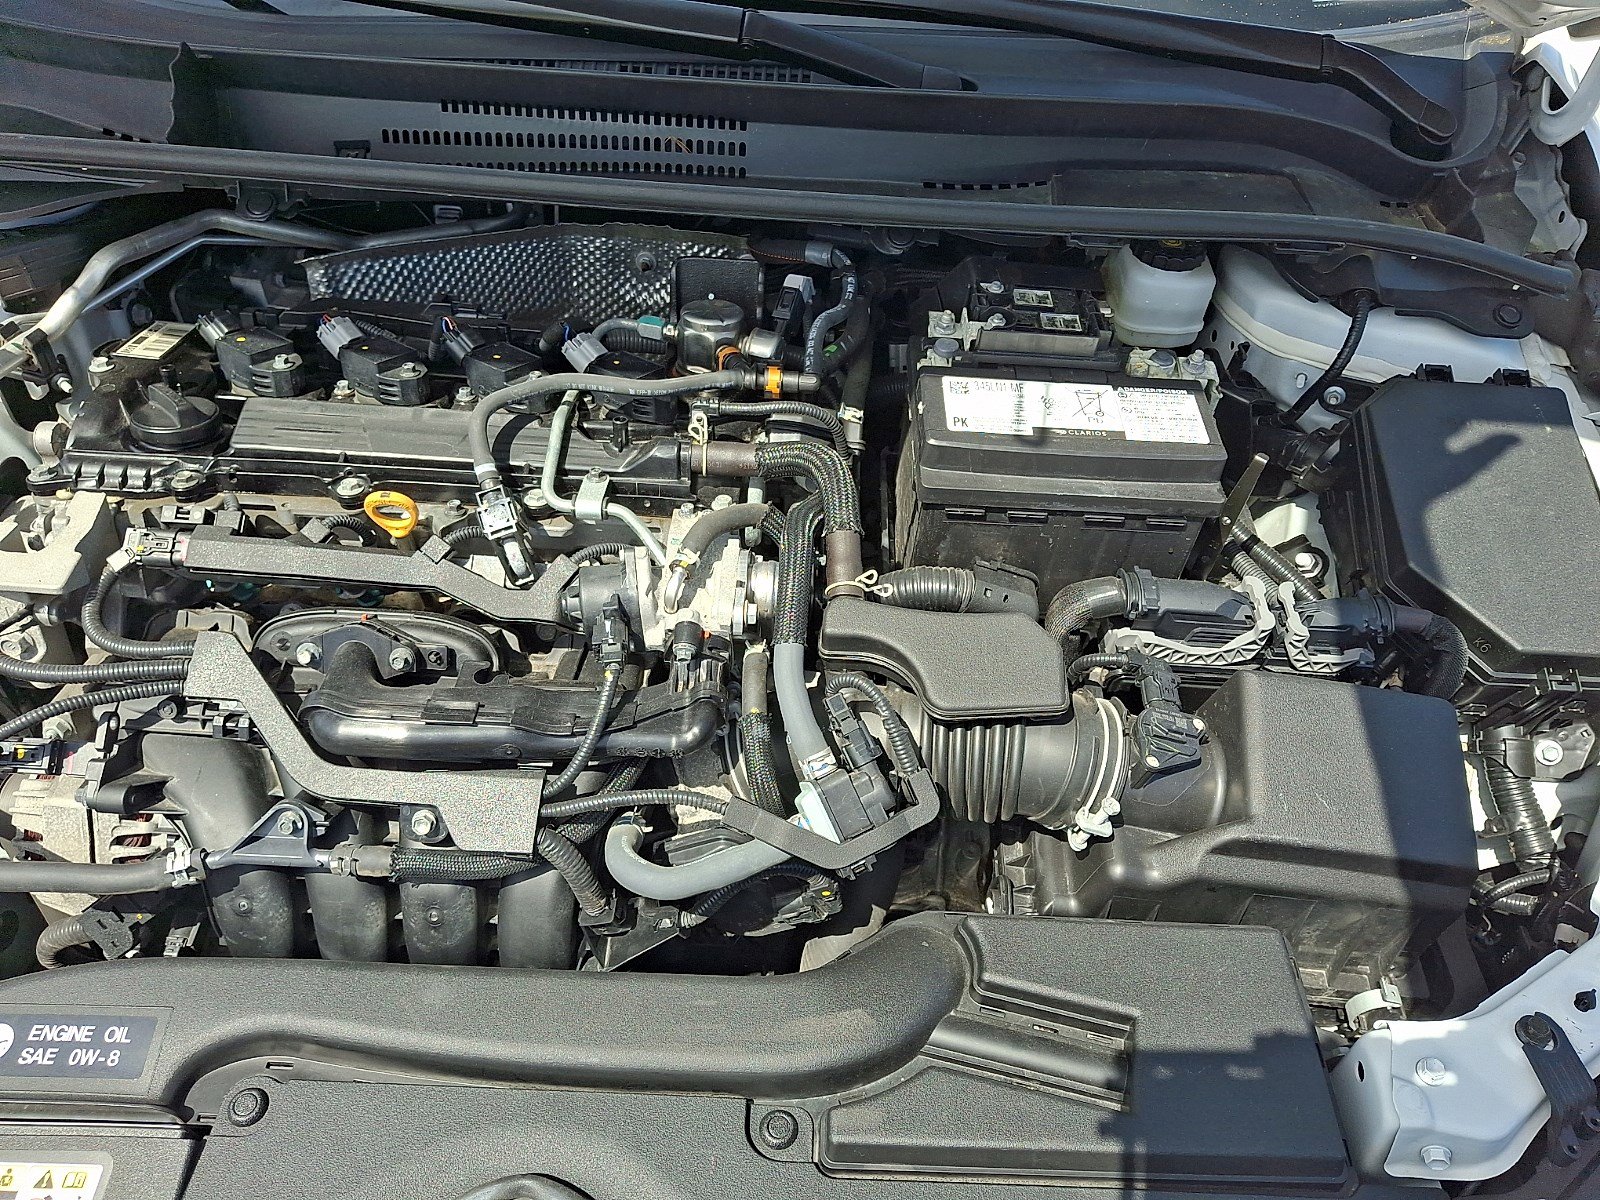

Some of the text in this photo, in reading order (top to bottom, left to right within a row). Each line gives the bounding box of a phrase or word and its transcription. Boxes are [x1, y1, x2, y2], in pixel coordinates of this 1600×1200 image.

[1124, 387, 1188, 395] DANGER/POISON
[953, 416, 969, 428] PK
[1068, 429, 1107, 437] CLARIOS
[1473, 636, 1491, 653] K6
[28, 1024, 132, 1043] ENGINE OIL
[18, 1047, 121, 1067] SAE 0W-8
